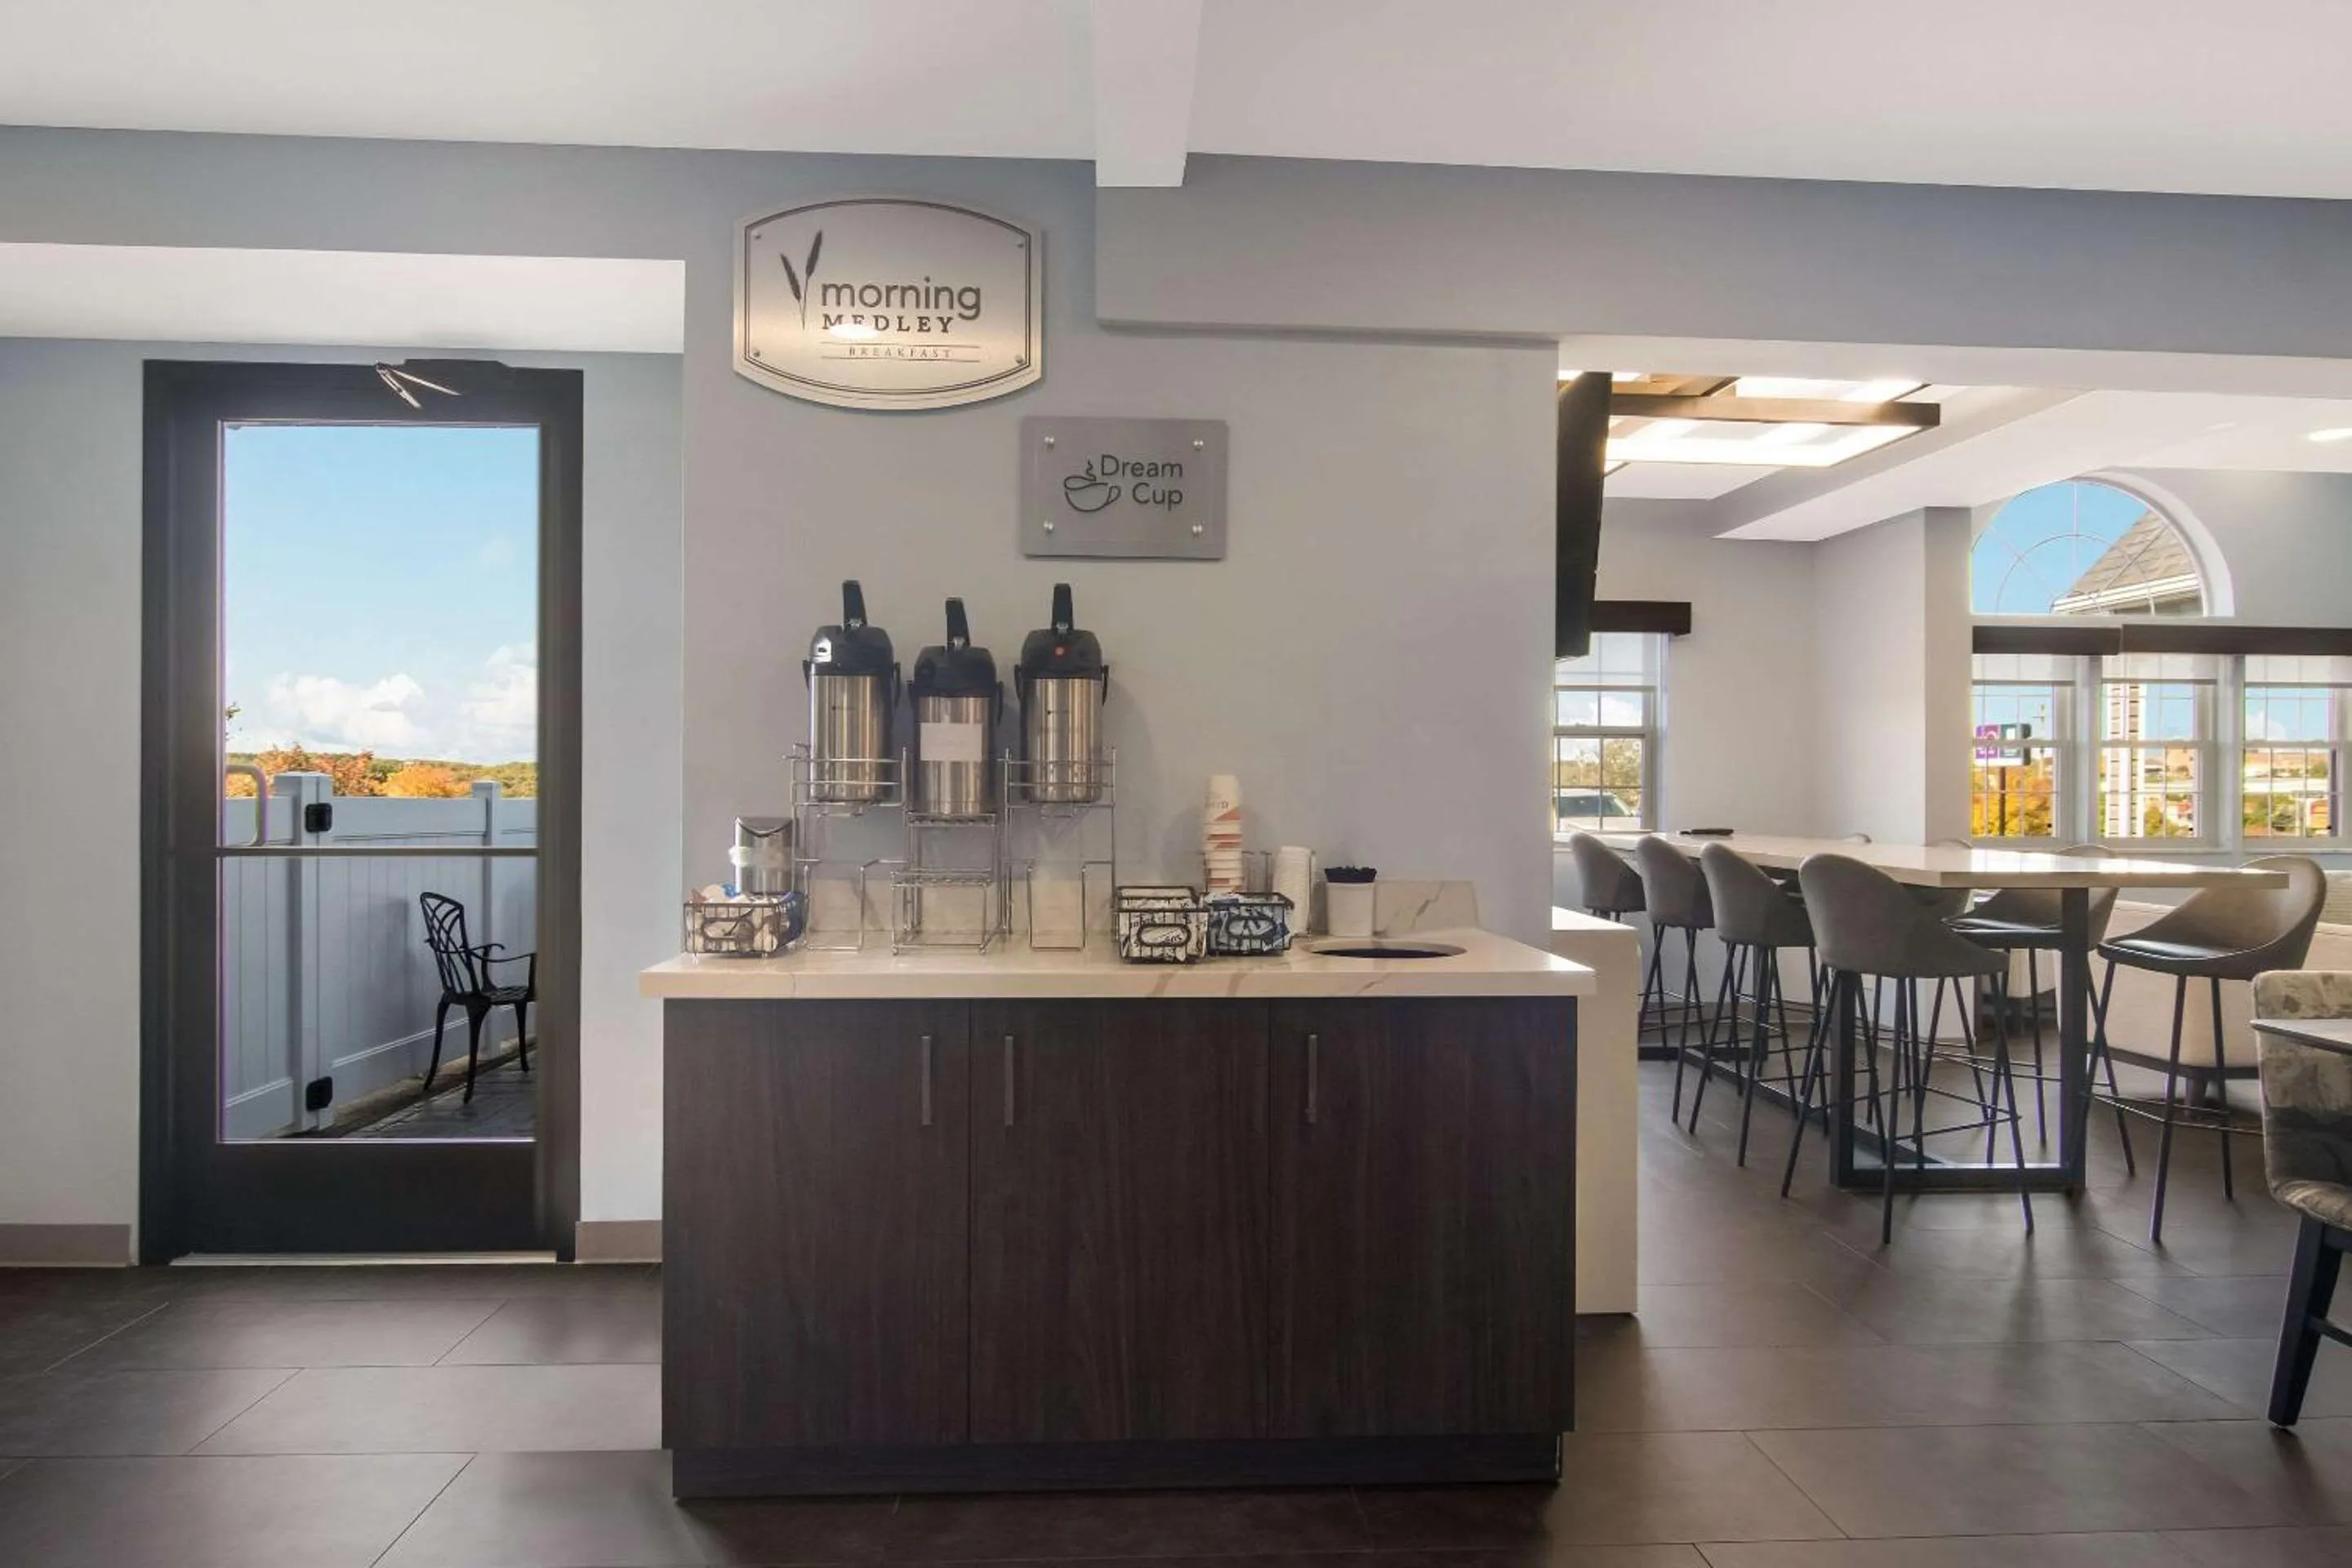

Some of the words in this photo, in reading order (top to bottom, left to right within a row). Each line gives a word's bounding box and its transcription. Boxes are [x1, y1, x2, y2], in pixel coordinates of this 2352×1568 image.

[821, 276, 981, 321] morning
[848, 346, 952, 359] BREAKFAST
[1101, 454, 1183, 478] Dream
[1132, 483, 1183, 510] Cup
